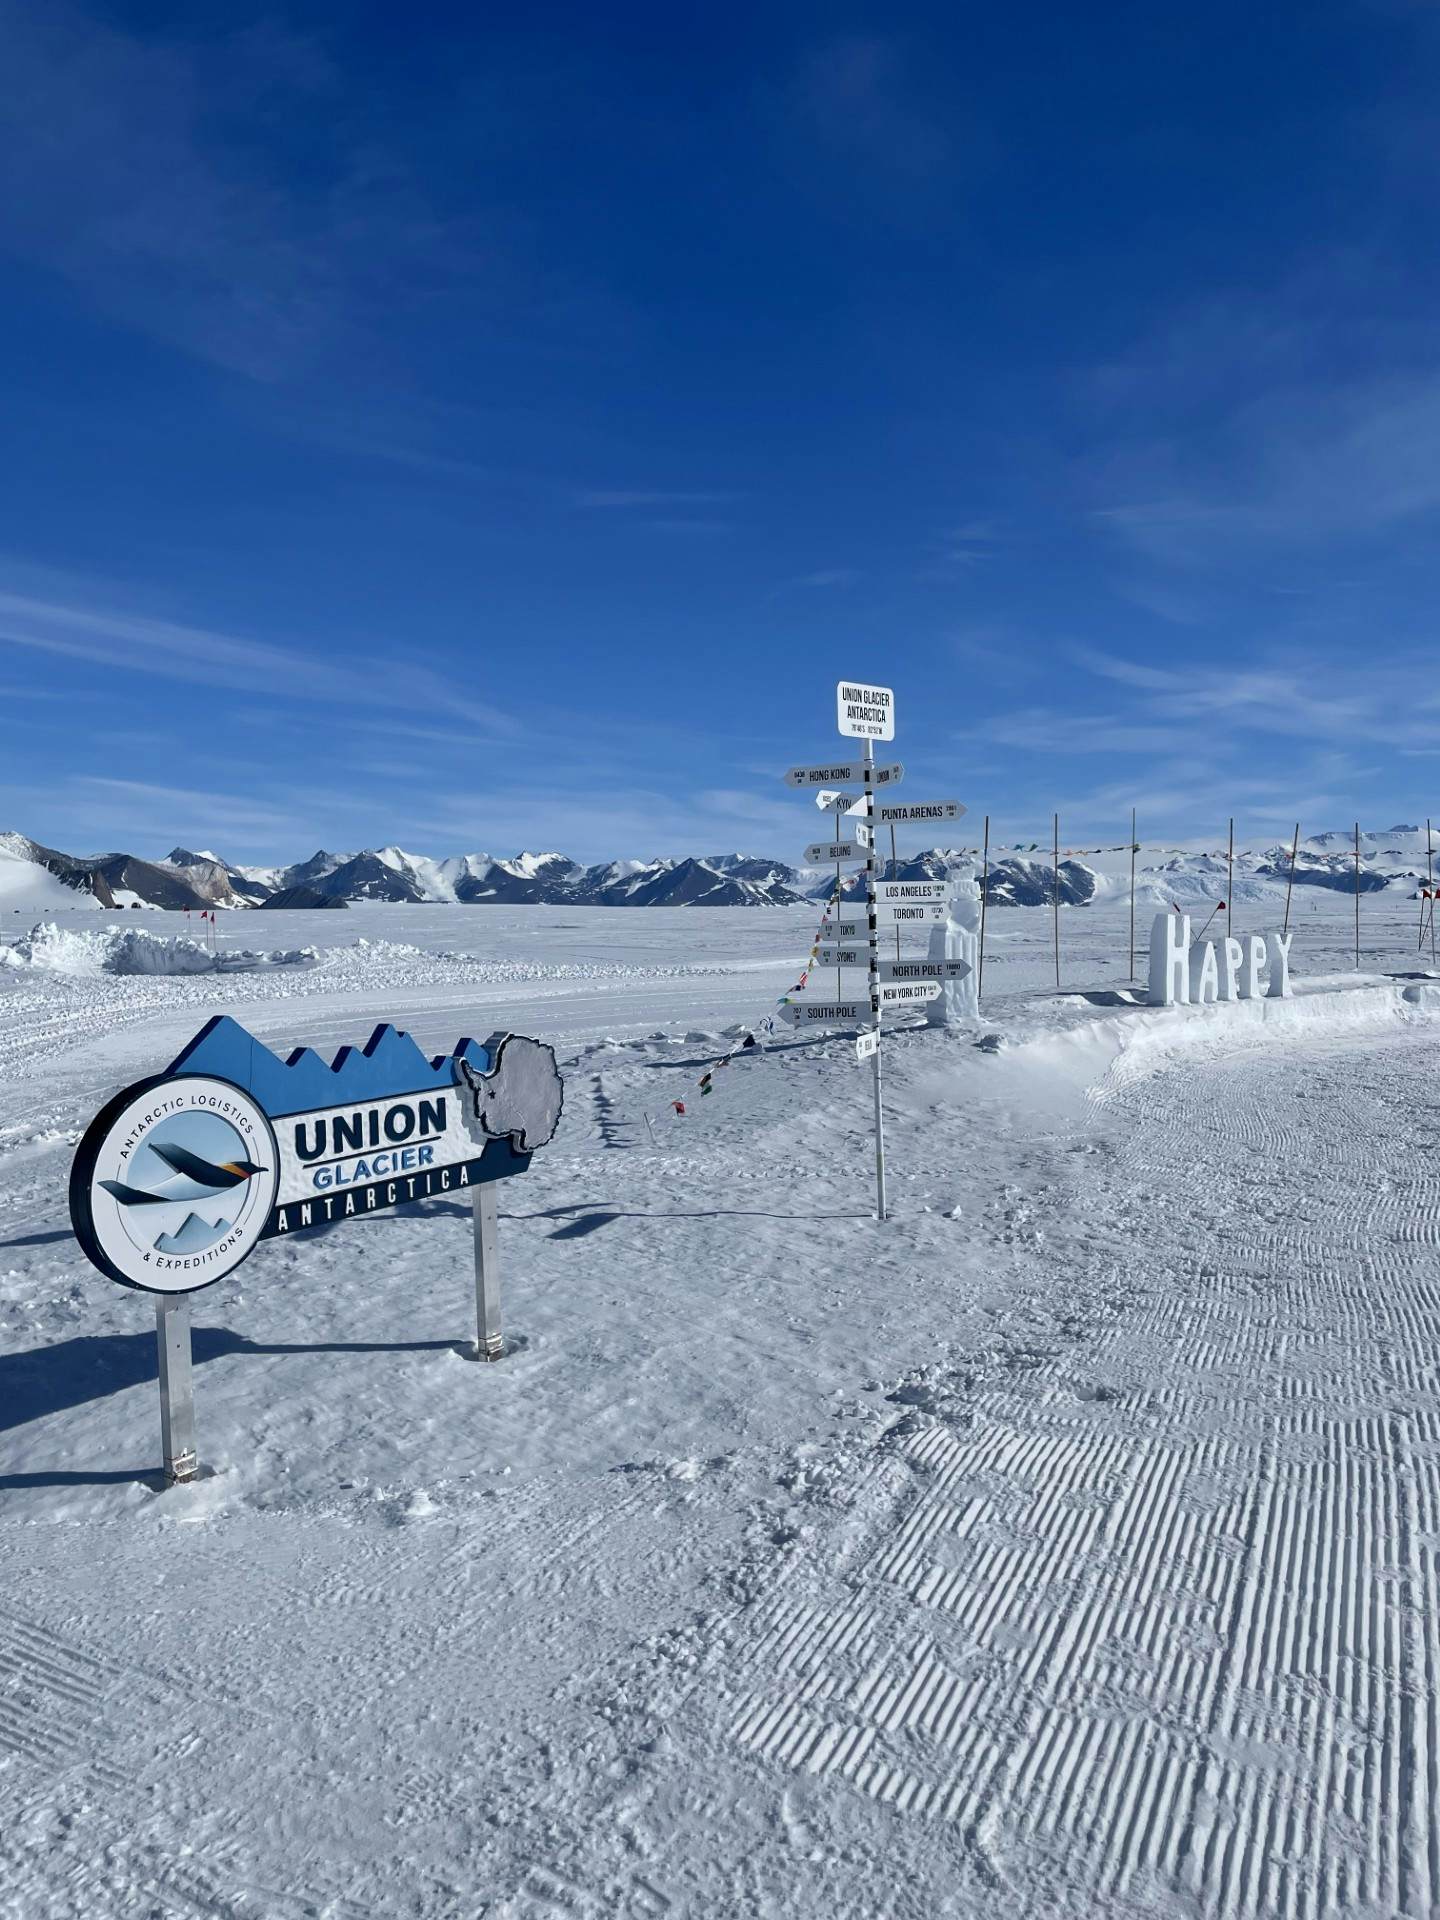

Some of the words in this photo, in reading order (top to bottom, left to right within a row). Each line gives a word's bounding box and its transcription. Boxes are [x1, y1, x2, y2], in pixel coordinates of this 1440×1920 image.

[843, 687, 862, 703] UNION
[863, 690, 890, 707] GLACIER
[847, 705, 886, 723] ANTARCTICA
[809, 770, 829, 782] HONG
[830, 767, 851, 780] KONG
[881, 808, 908, 820] PUNTA
[909, 806, 943, 818] ARENAS
[829, 845, 851, 858] BEIJING
[885, 886, 899, 898] LOS
[900, 886, 932, 897] ANGELES
[893, 908, 924, 919] TORONTO
[839, 924, 856, 936] TOKYO
[836, 951, 857, 963] SYDNEY
[1158, 913, 1295, 1006] HAPPY
[892, 965, 920, 977] NORTH
[921, 964, 943, 976] POLE
[883, 988, 897, 1000] NEW
[897, 987, 913, 999] YORK
[914, 985, 928, 997] CITY
[807, 1007, 834, 1019] SOUTH
[836, 1006, 857, 1018] POLE
[120, 1096, 185, 1159] ANTARCTIC
[191, 1094, 254, 1134] LOGISTICS
[295, 1097, 447, 1162] UNION
[312, 1144, 435, 1190] GLACIER
[278, 1165, 470, 1232] ANTARCTICA
[142, 1252, 151, 1262] &
[155, 1227, 244, 1270] EXPEDITIONS
